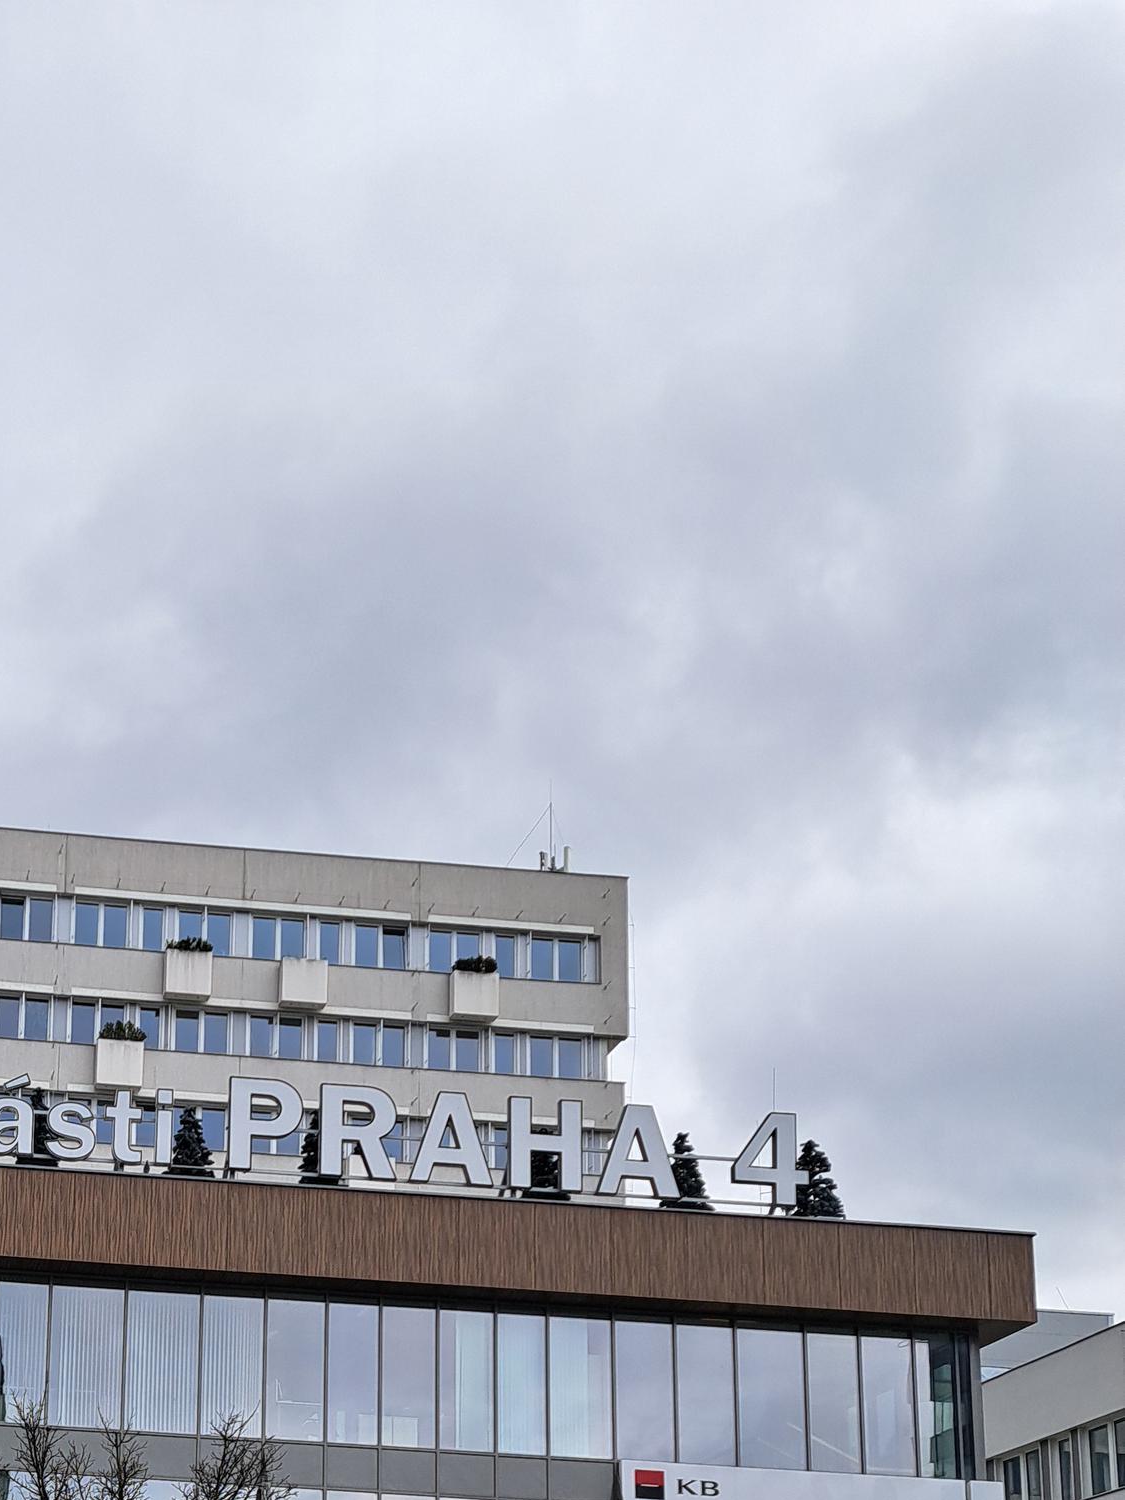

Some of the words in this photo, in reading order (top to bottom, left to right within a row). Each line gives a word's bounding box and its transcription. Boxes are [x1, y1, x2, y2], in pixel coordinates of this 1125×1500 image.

[228, 1075, 680, 1200] PRAHA
[730, 1110, 810, 1207] 4
[676, 1478, 720, 1497] KB
